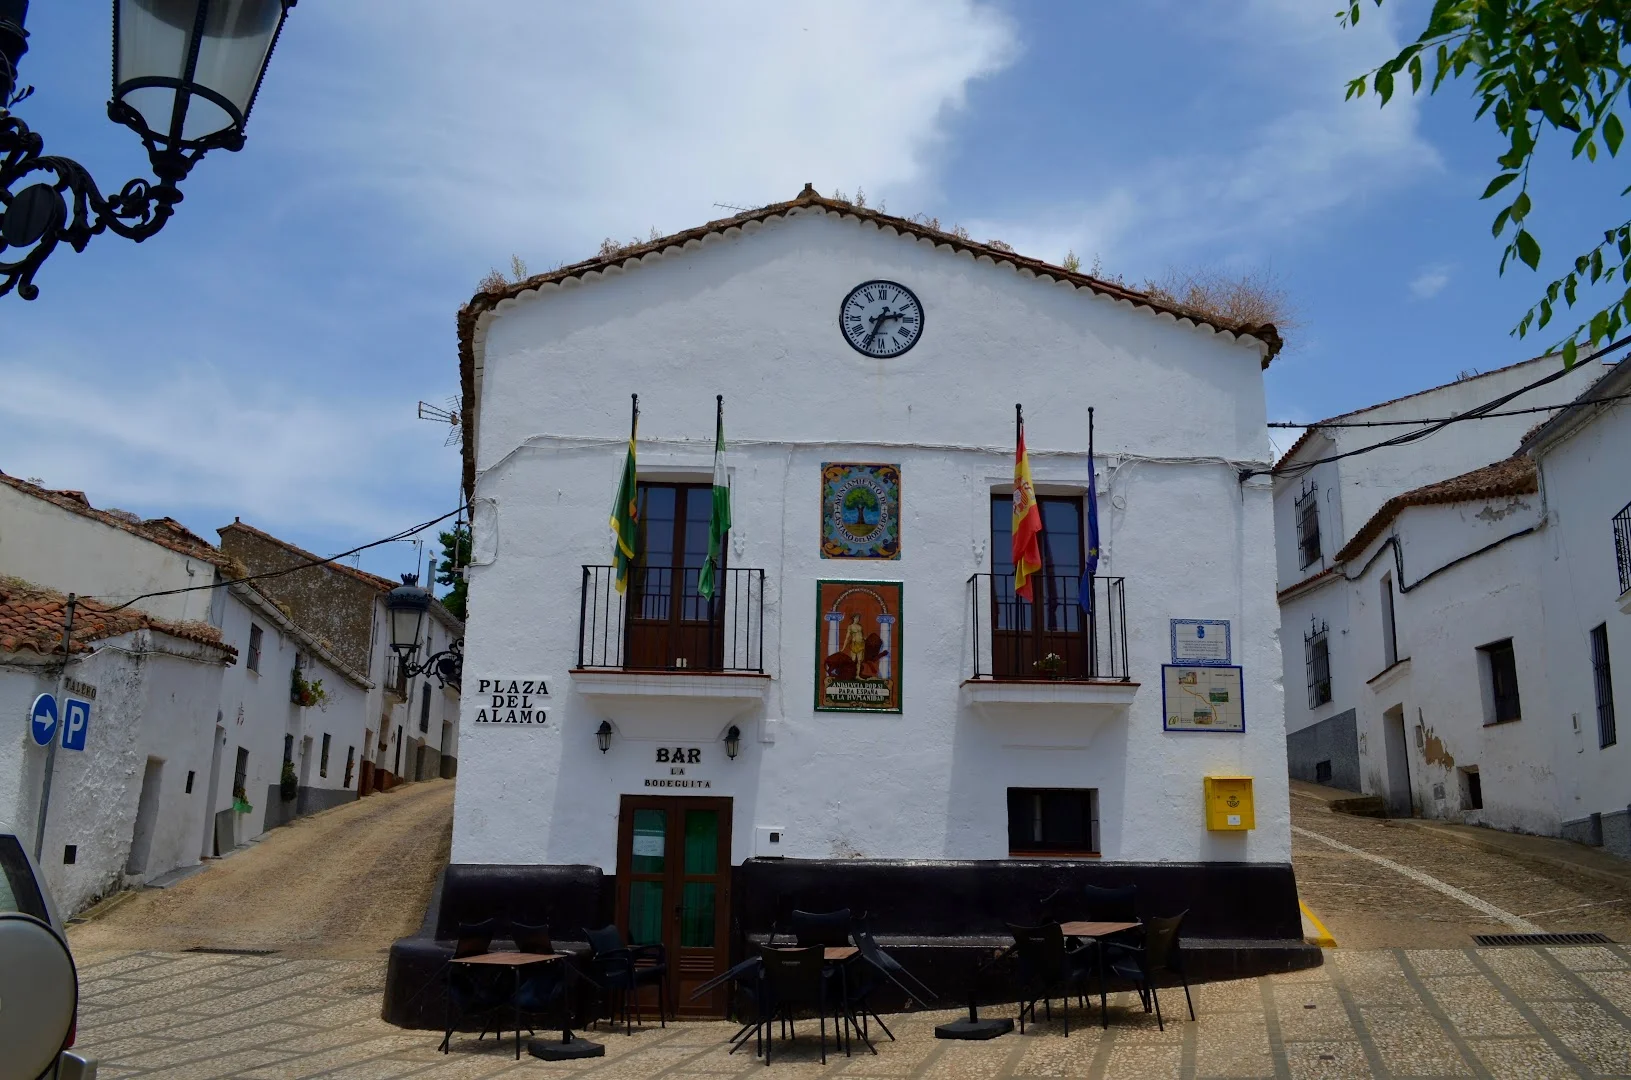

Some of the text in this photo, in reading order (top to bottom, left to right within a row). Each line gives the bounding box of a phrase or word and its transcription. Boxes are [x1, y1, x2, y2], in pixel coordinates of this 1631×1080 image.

[878, 289, 887, 300] XII
[835, 478, 882, 506] AYUNTAMIENTO
[866, 512, 888, 541] ROBLEDO
[478, 679, 549, 695] PLAZA
[491, 694, 533, 709] DEL
[475, 708, 547, 724] ALAMO
[67, 706, 84, 743] P
[655, 747, 701, 764] BAR
[644, 779, 712, 788] BODEGUITA
